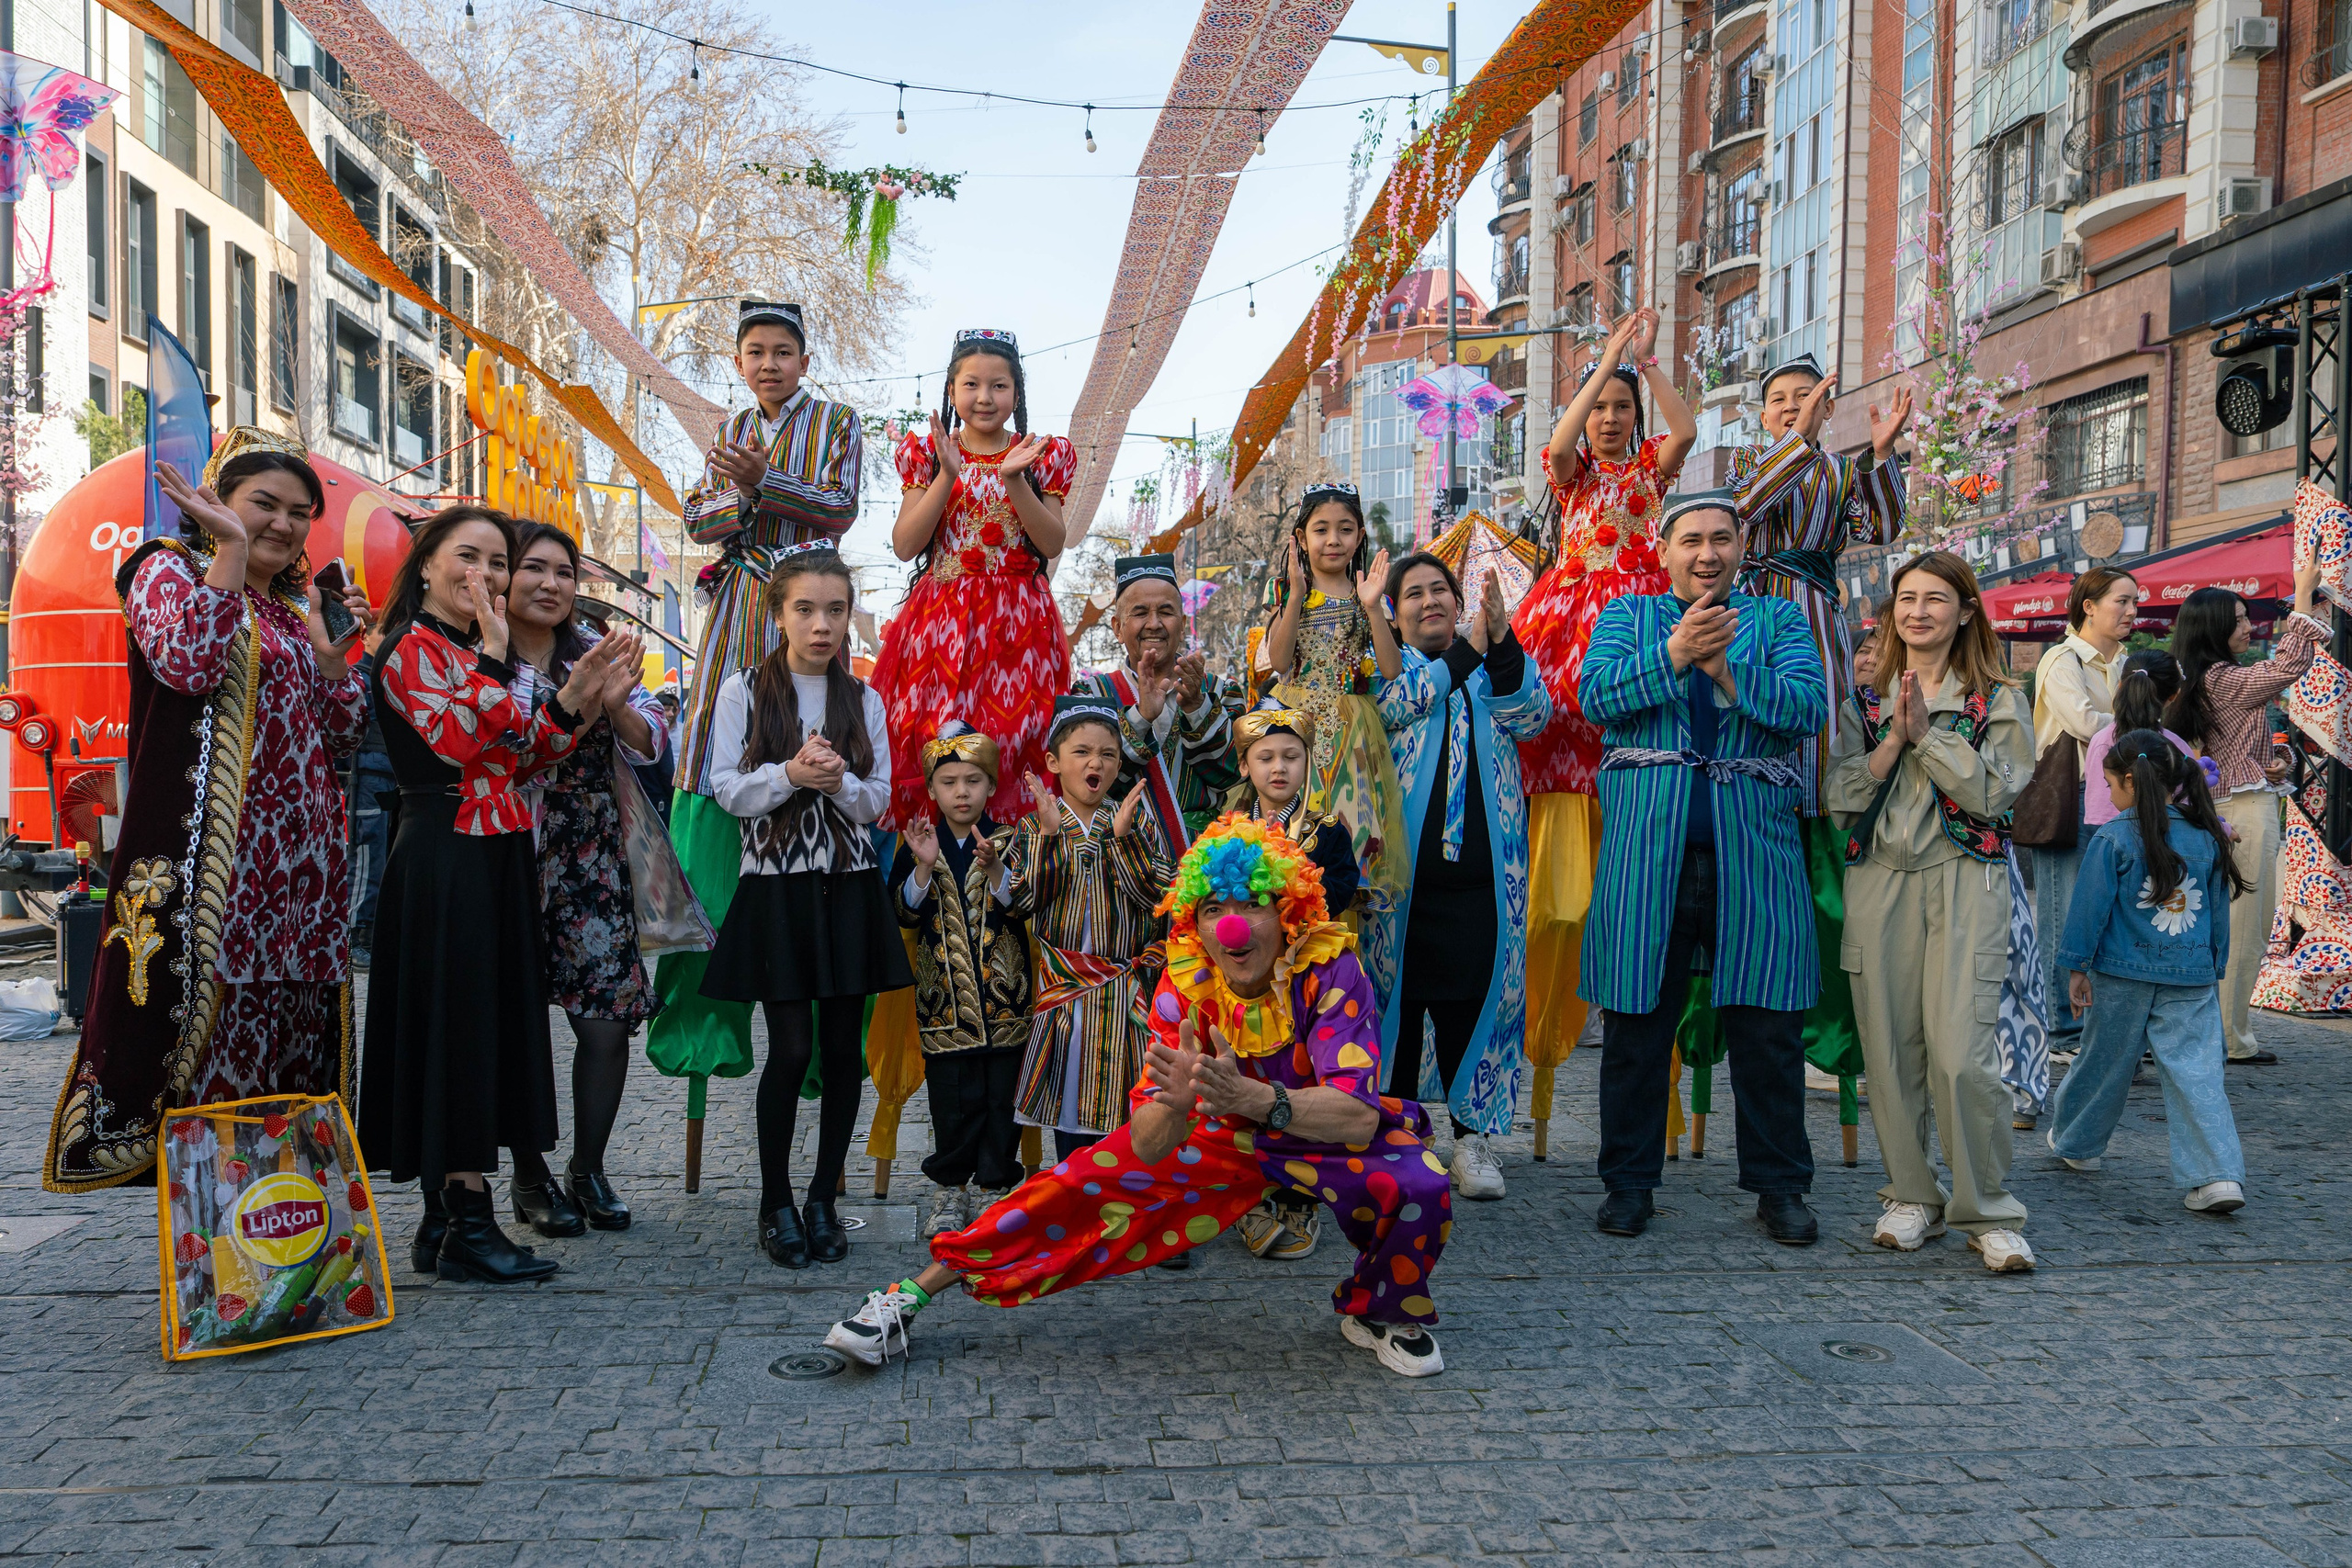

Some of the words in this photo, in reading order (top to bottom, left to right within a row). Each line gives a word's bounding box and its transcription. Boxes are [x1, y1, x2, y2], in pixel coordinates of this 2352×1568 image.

[466, 348, 579, 494] Oqtepa
[2013, 598, 2041, 616] Wendy's
[249, 1208, 319, 1234] Lipton
